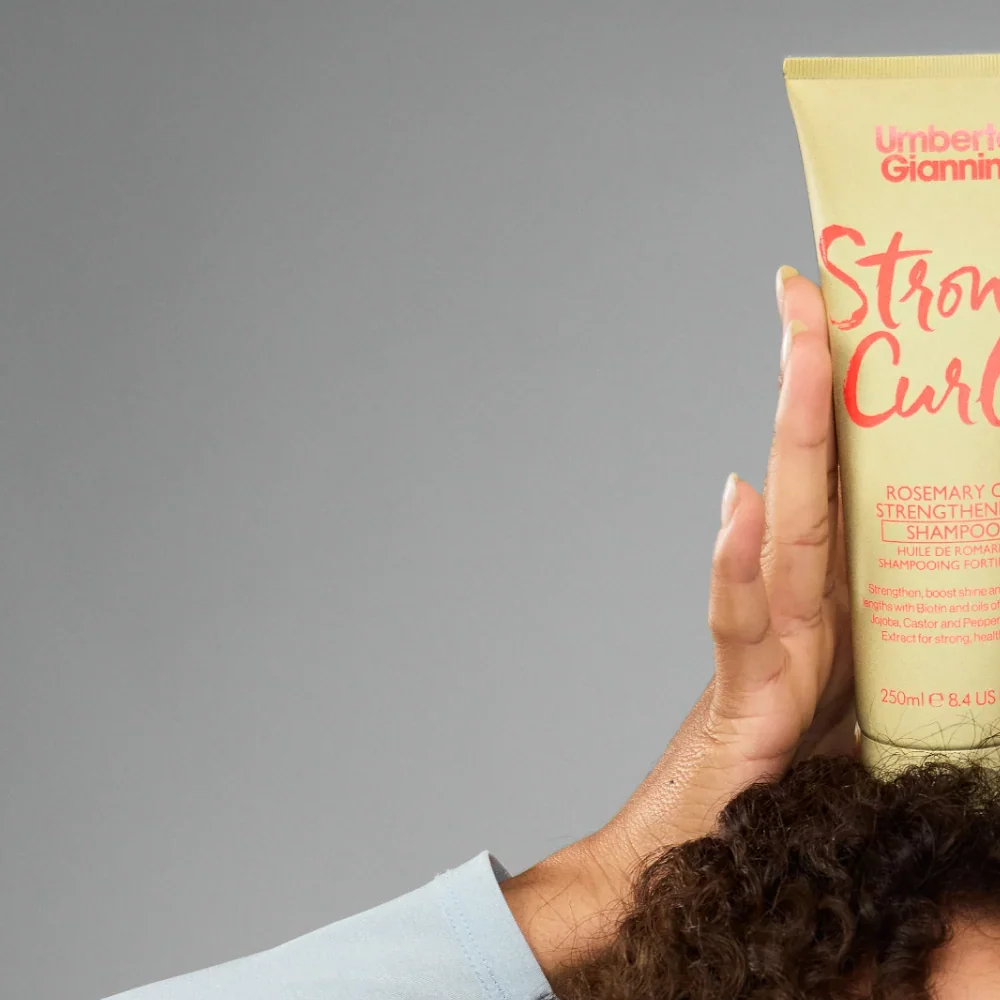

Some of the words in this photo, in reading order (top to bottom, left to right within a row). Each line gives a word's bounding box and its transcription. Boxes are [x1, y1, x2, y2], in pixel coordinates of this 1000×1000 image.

[886, 484, 985, 501] ROSEMARY
[906, 522, 1000, 540] SHAMPOO
[897, 545, 931, 557] HUILE
[934, 545, 951, 557] DE
[878, 558, 960, 571] SHAMPOOING
[868, 583, 924, 599] Strengthen,
[925, 587, 957, 598] boost
[958, 586, 987, 598] shine
[894, 602, 915, 613] with
[916, 603, 947, 613] Biotin
[949, 602, 970, 613] and
[971, 600, 989, 612] oils
[990, 600, 1000, 611] of
[870, 613, 902, 628] Jojoba,
[903, 617, 938, 629] Castor
[940, 618, 961, 629] and
[881, 630, 916, 643] Extract
[918, 633, 932, 644] for
[934, 634, 972, 645] strong,
[880, 688, 925, 707] 250ml
[948, 692, 971, 707] 8.4
[975, 689, 996, 706] US
